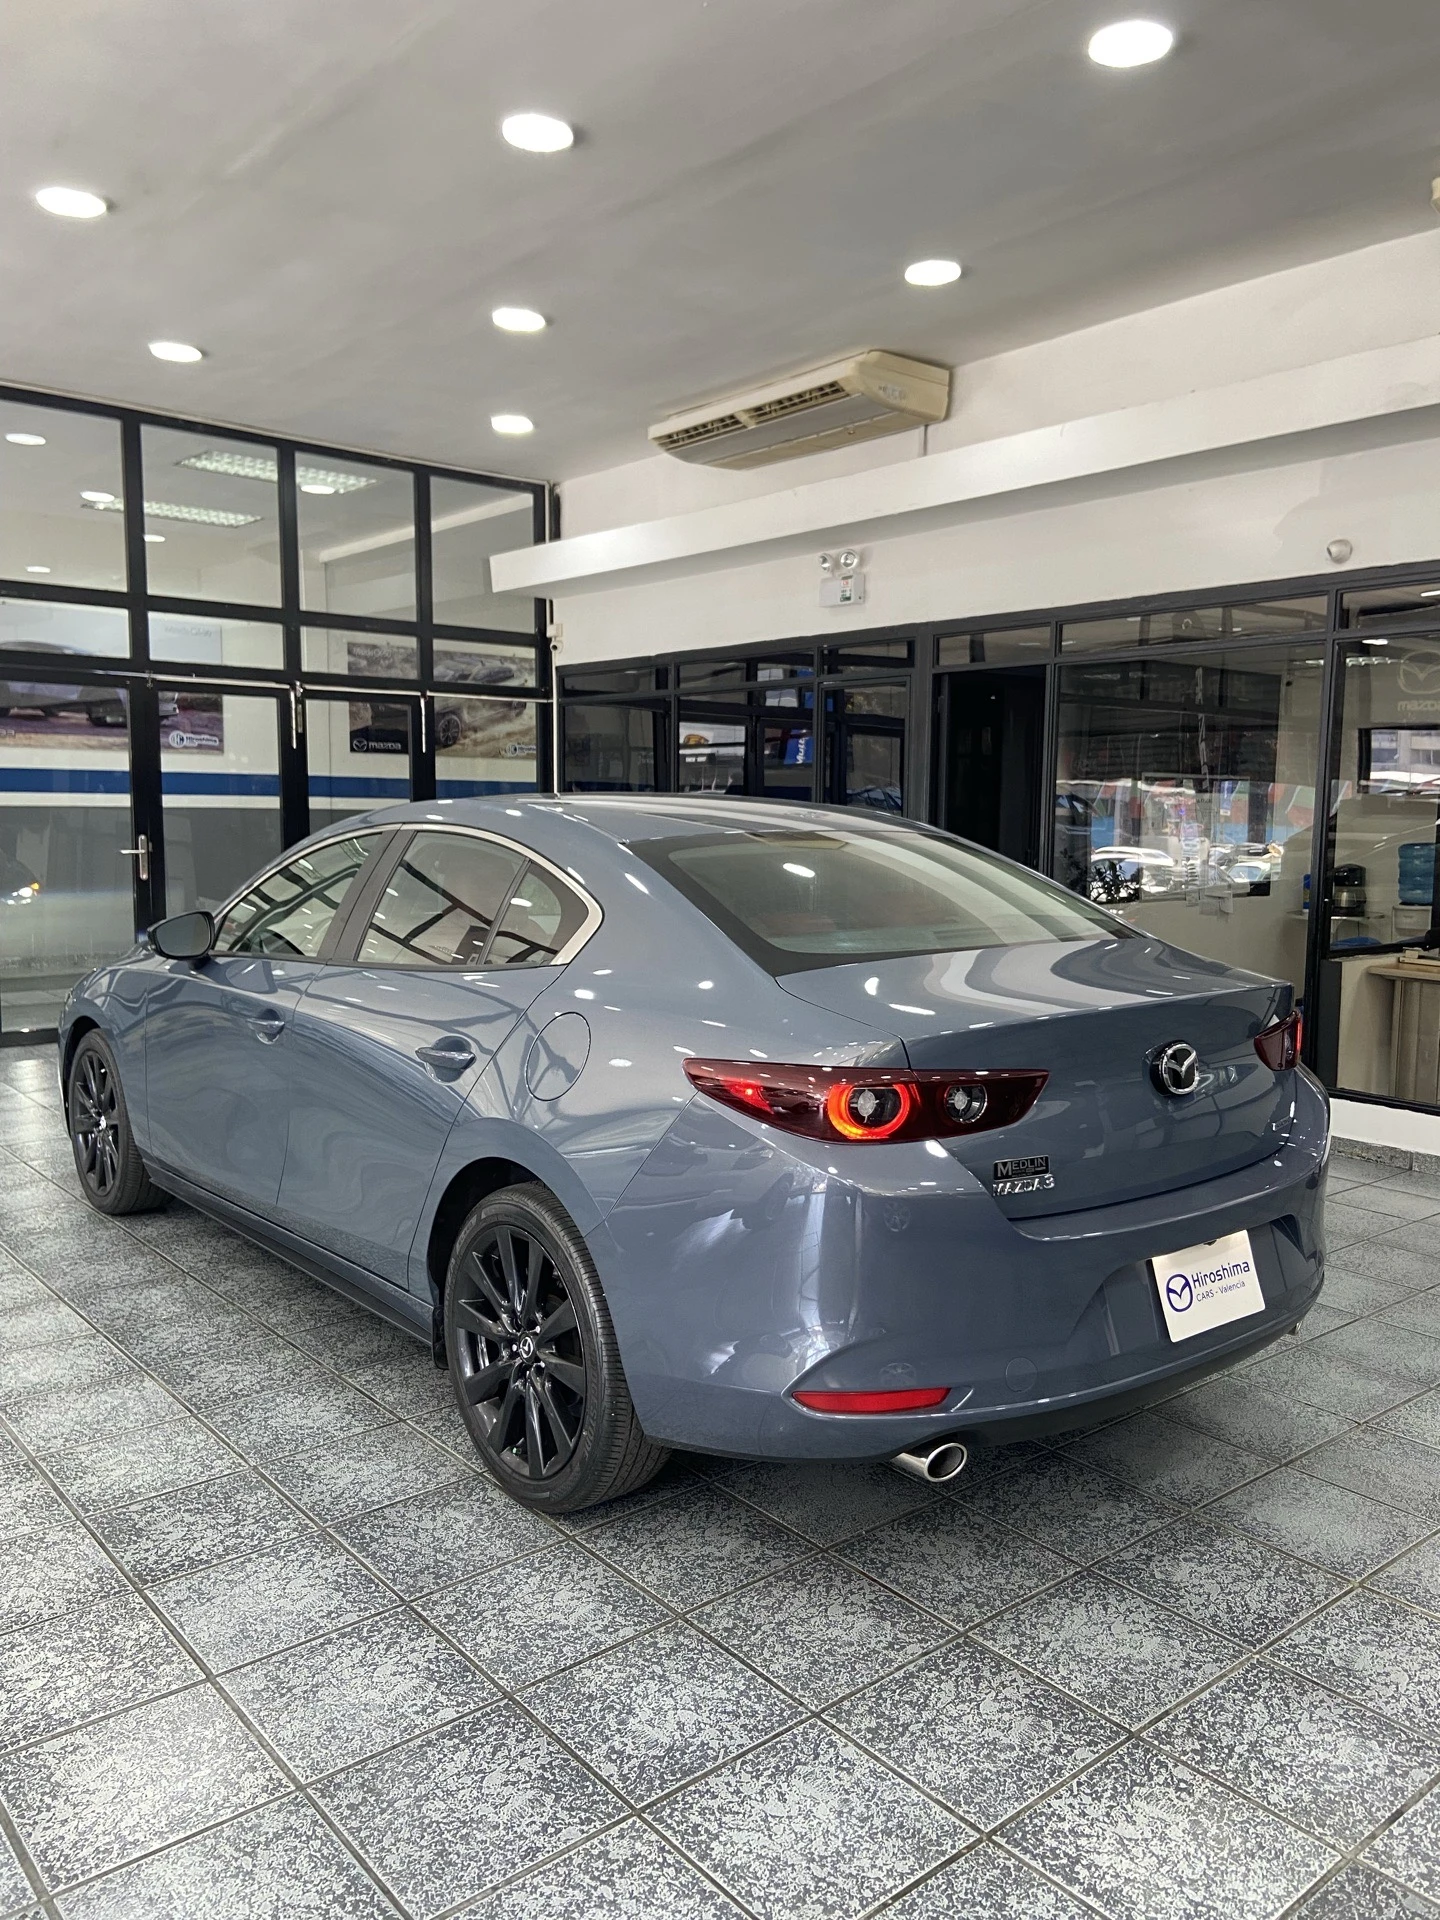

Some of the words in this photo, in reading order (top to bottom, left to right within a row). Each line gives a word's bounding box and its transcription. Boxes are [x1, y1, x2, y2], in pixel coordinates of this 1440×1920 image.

[369, 741, 401, 750] mazda
[997, 1157, 1046, 1177] MEDLIN
[1191, 1261, 1250, 1289] Hiroshima
[1196, 1289, 1215, 1302] CARS
[1219, 1280, 1246, 1294] Valencia
